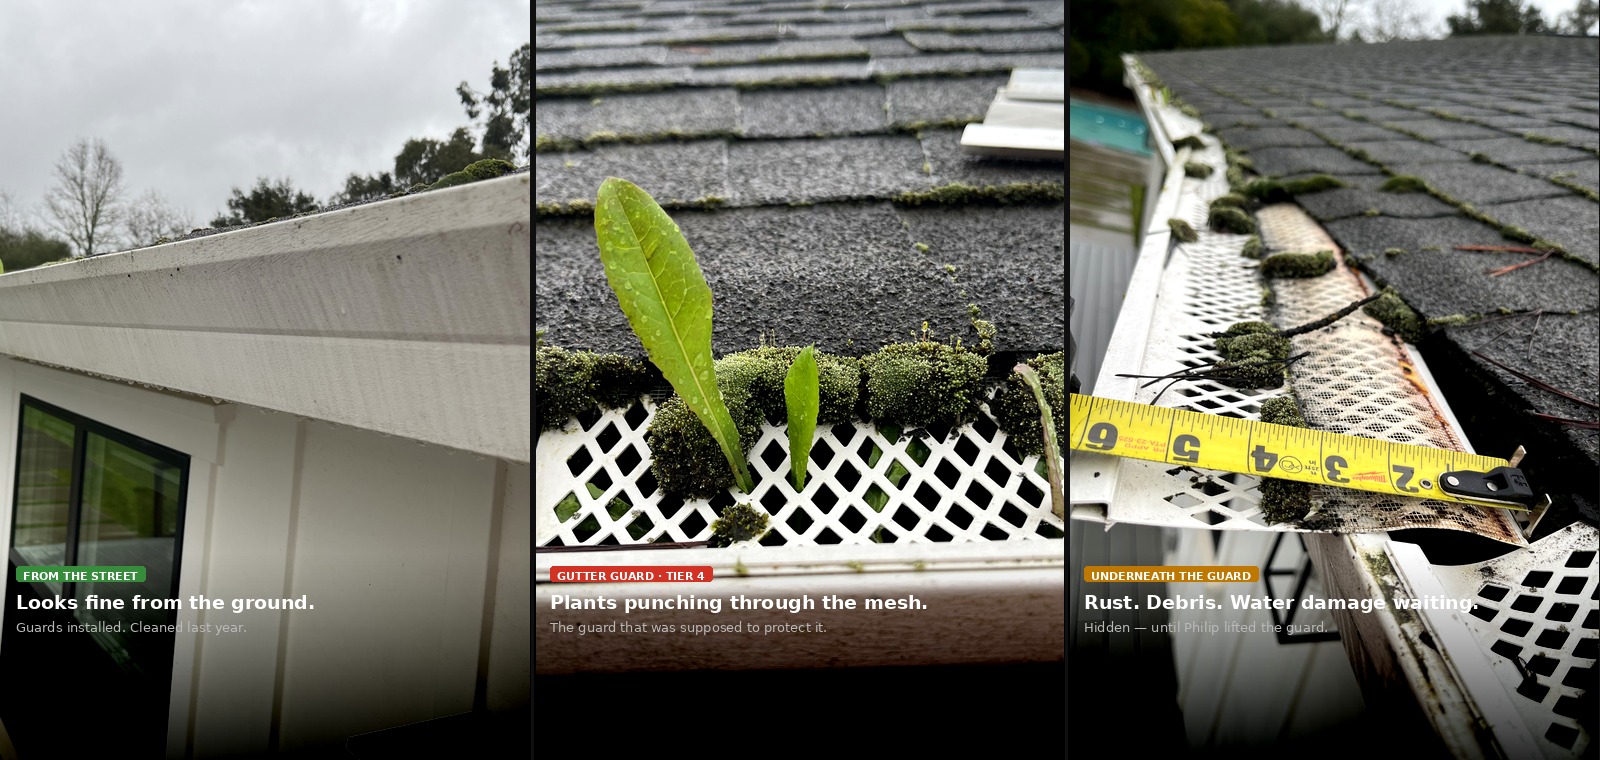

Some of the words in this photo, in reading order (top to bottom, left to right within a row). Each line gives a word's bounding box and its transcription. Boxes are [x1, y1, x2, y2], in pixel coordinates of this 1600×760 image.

[1085, 422, 1118, 451] 6
[1124, 443, 1149, 451] APPD
[1173, 434, 1201, 463] 5
[1251, 445, 1278, 472] 4
[1324, 455, 1350, 483] 3
[1392, 464, 1419, 493] 2
